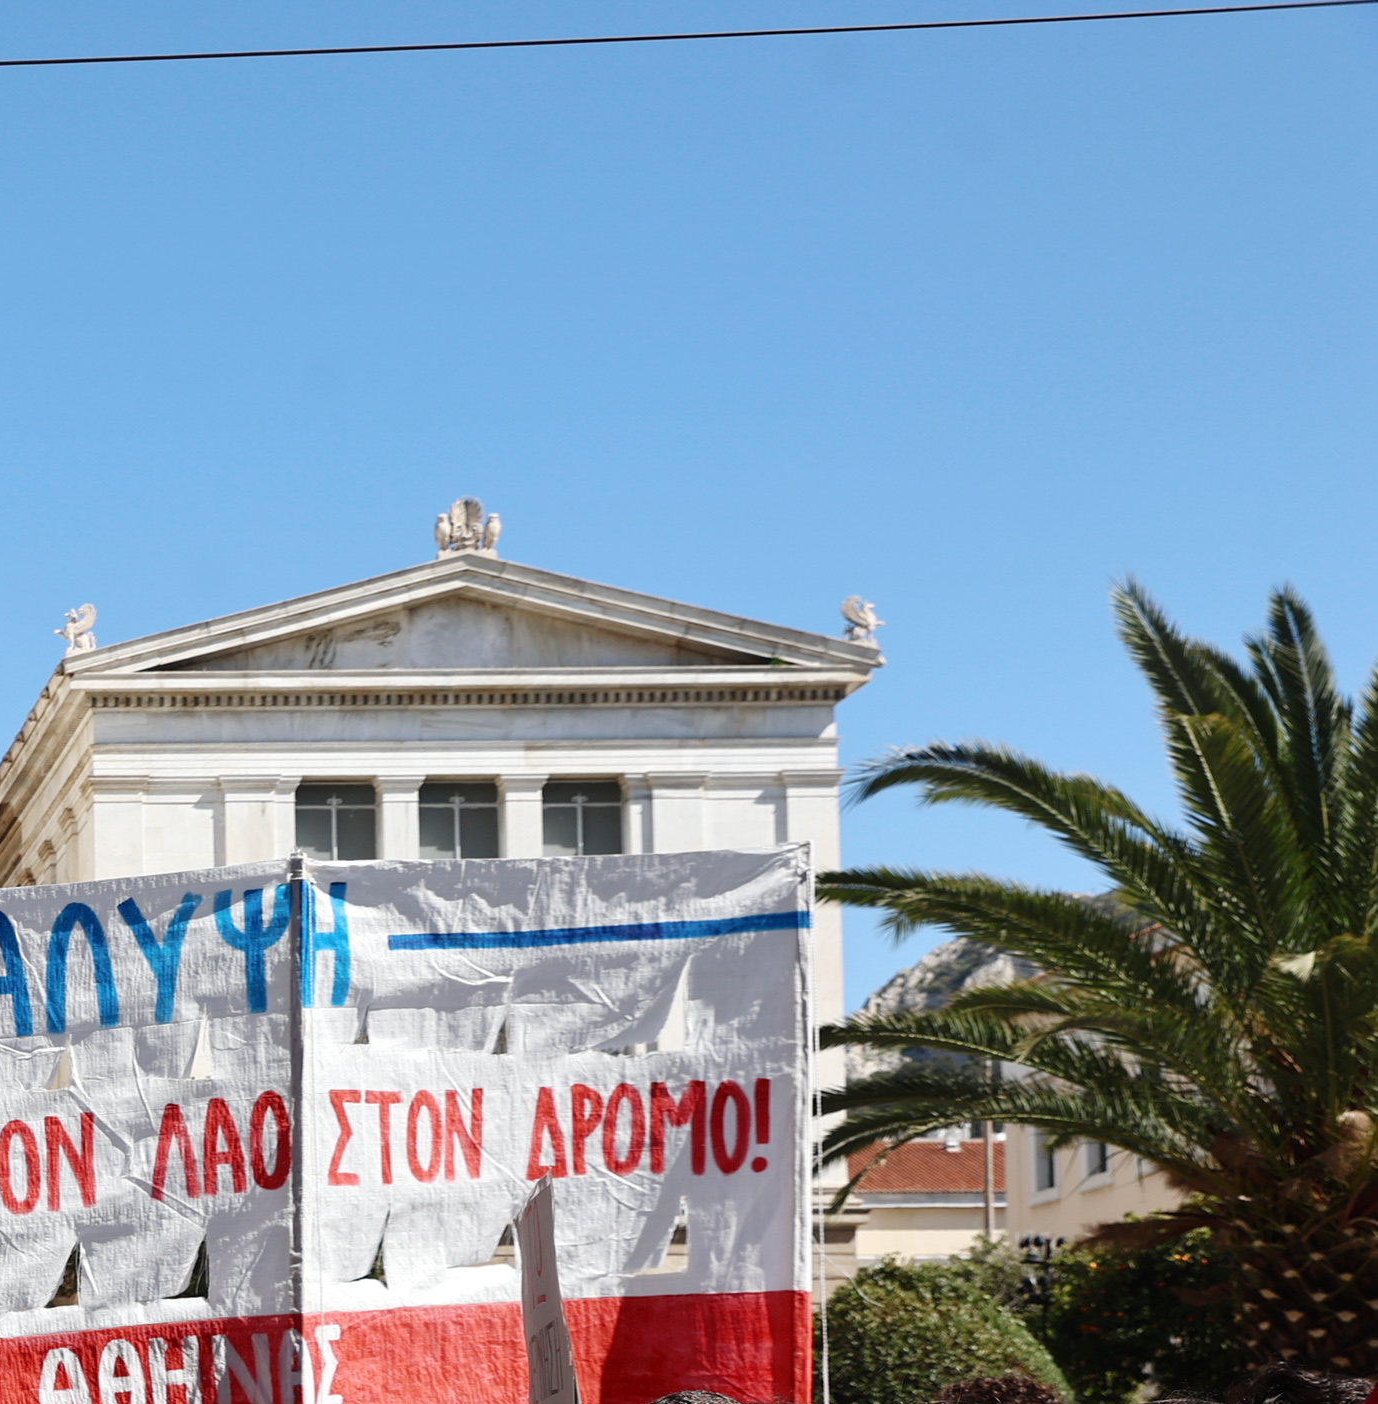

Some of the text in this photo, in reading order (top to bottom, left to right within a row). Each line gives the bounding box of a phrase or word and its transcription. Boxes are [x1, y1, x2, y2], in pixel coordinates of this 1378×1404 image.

[151, 1090, 292, 1201] ΛΑΟ
[328, 1087, 483, 1186] ΣΤΟΝ
[526, 1077, 771, 1181] ΔΡΟΜΟ!
